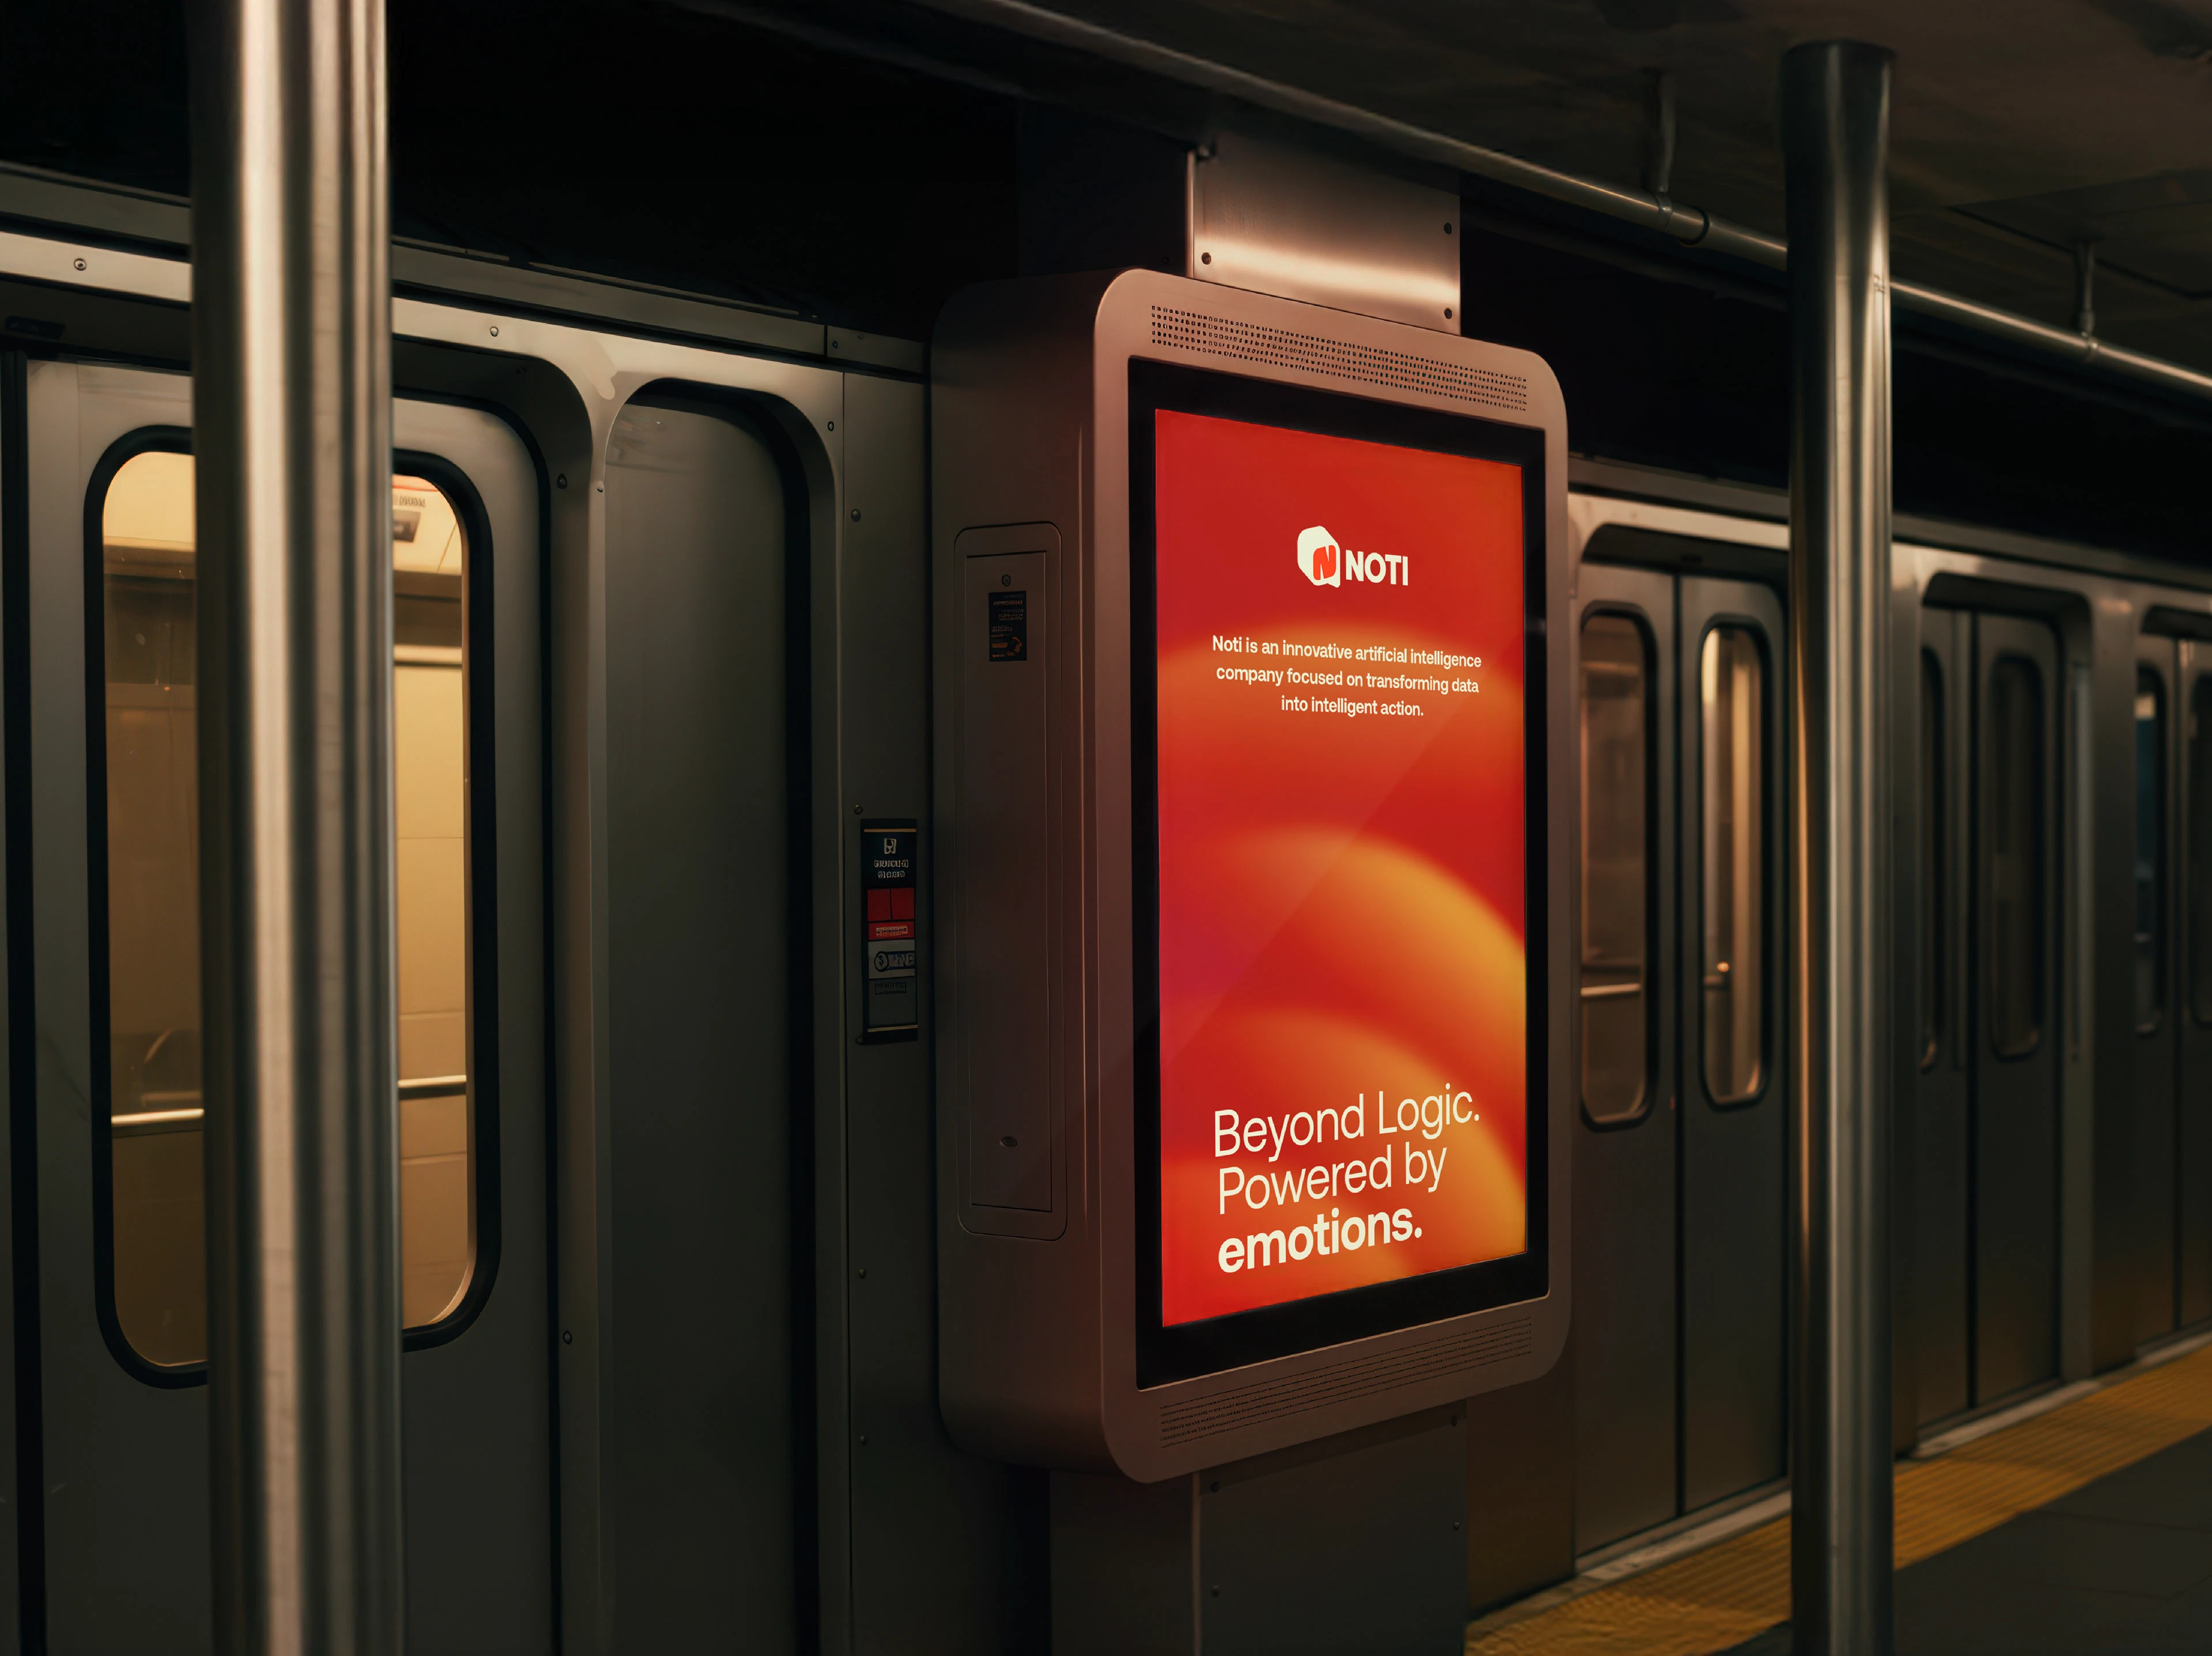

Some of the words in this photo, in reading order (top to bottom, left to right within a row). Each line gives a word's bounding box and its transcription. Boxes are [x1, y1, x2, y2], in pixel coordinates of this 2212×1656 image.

[1345, 550, 1408, 586] NOTI
[1213, 635, 1243, 653] Noti
[1245, 636, 1258, 653] is
[1262, 642, 1279, 655] an
[1282, 639, 1353, 660] innovative
[1355, 646, 1407, 664] artificial
[1410, 648, 1482, 670] intelligence
[1216, 667, 1284, 687] company
[1286, 668, 1343, 686] focused
[1346, 674, 1363, 687] on
[1366, 673, 1449, 695] transforming
[1451, 677, 1479, 693] data
[1281, 695, 1308, 712] into
[1311, 696, 1378, 718] intelligent
[1380, 700, 1424, 717] action.
[1214, 1093, 1364, 1163] Beyond
[1378, 1082, 1480, 1140] Logic.
[1219, 1144, 1392, 1215] Powered
[1404, 1141, 1448, 1193] by
[1218, 1207, 1423, 1274] emotions.
